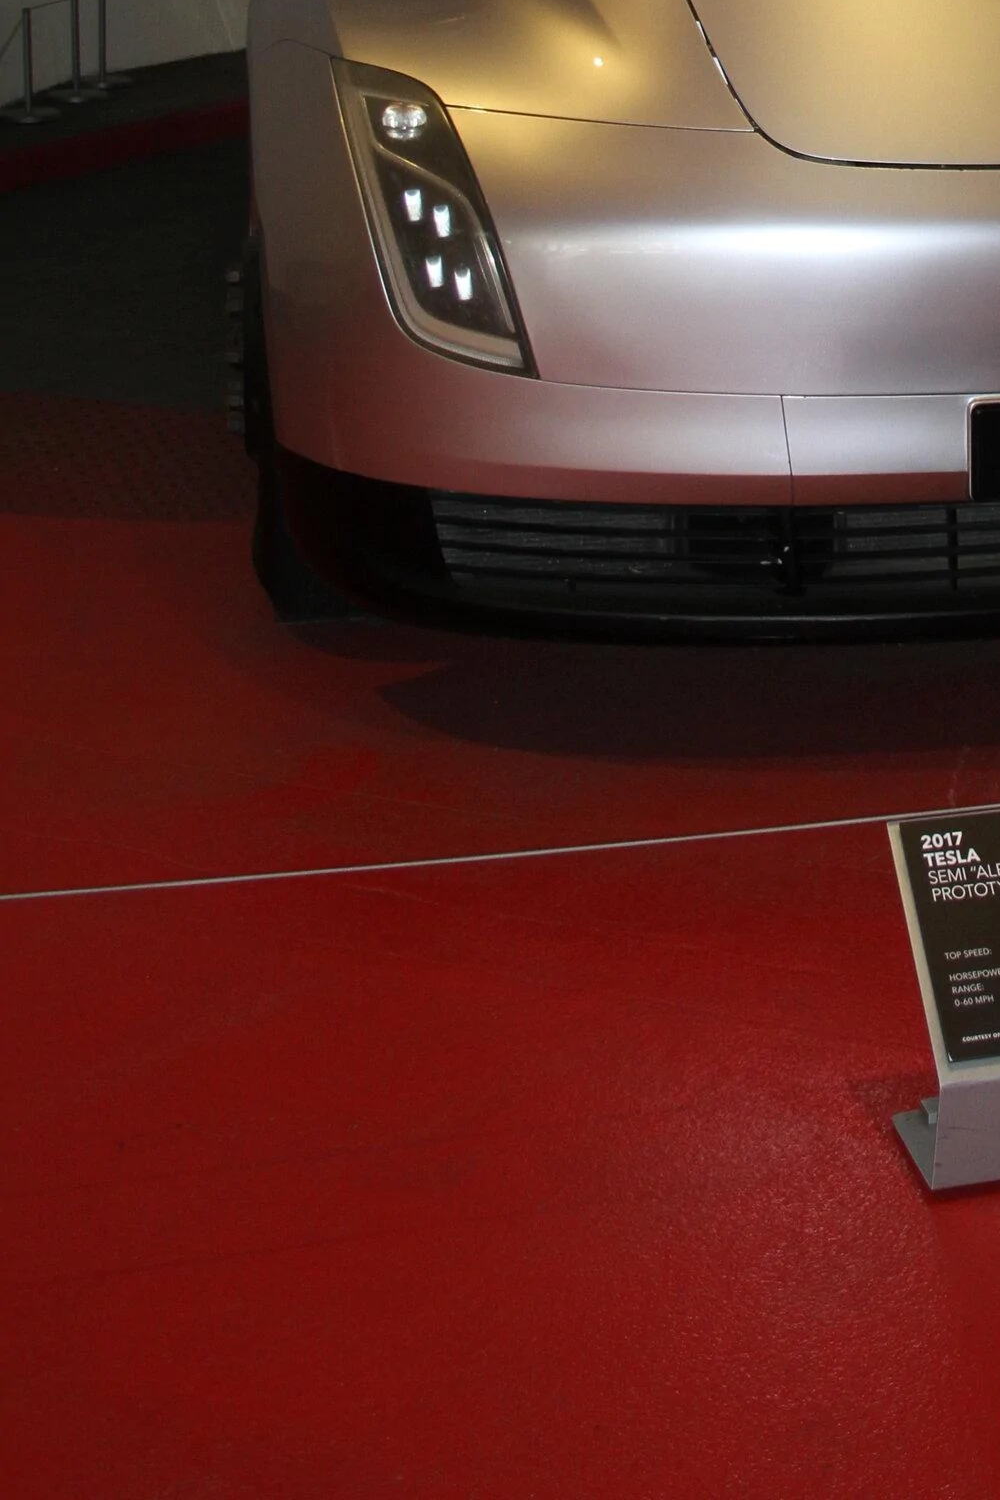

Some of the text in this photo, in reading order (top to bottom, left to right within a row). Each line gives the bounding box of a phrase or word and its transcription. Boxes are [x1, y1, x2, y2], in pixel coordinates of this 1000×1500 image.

[920, 831, 962, 849] 2017
[922, 847, 980, 867] TESLA
[927, 866, 966, 884] SEMI
[944, 950, 961, 959] TOP
[954, 994, 994, 1006] 0-60 MPH
